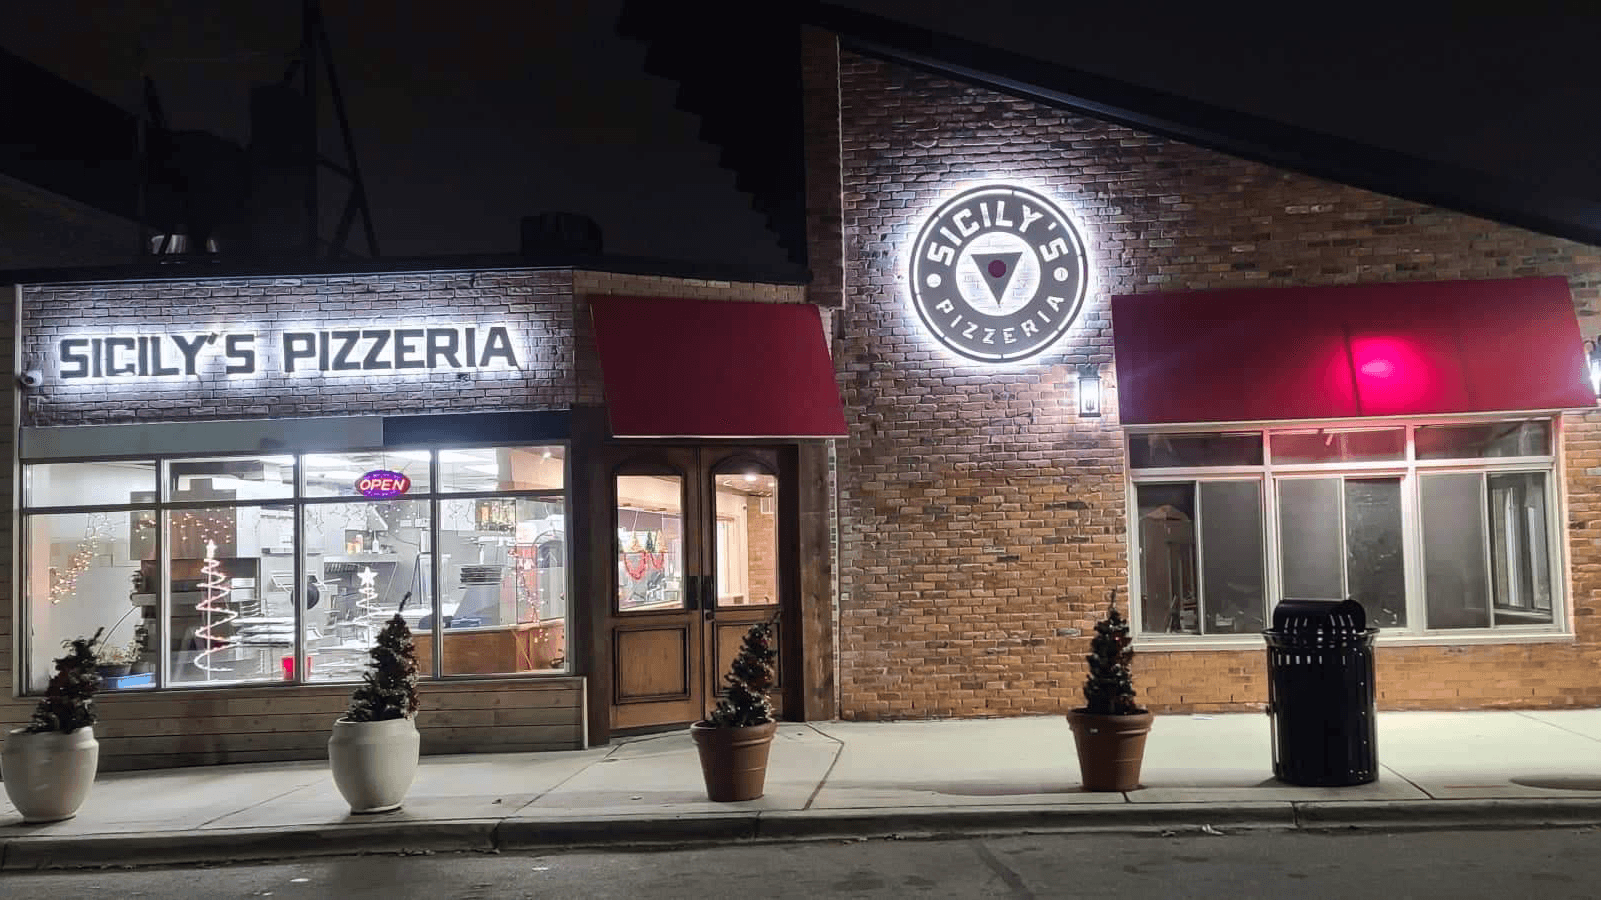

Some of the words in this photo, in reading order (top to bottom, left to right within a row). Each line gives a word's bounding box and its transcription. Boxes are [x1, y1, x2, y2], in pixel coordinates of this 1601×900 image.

[926, 200, 1069, 267] SICILY'S
[935, 295, 1065, 345] PIZZERIA
[59, 332, 256, 379] SICILY'S
[282, 326, 520, 374] PIZZERIA
[359, 478, 406, 491] OPEN
